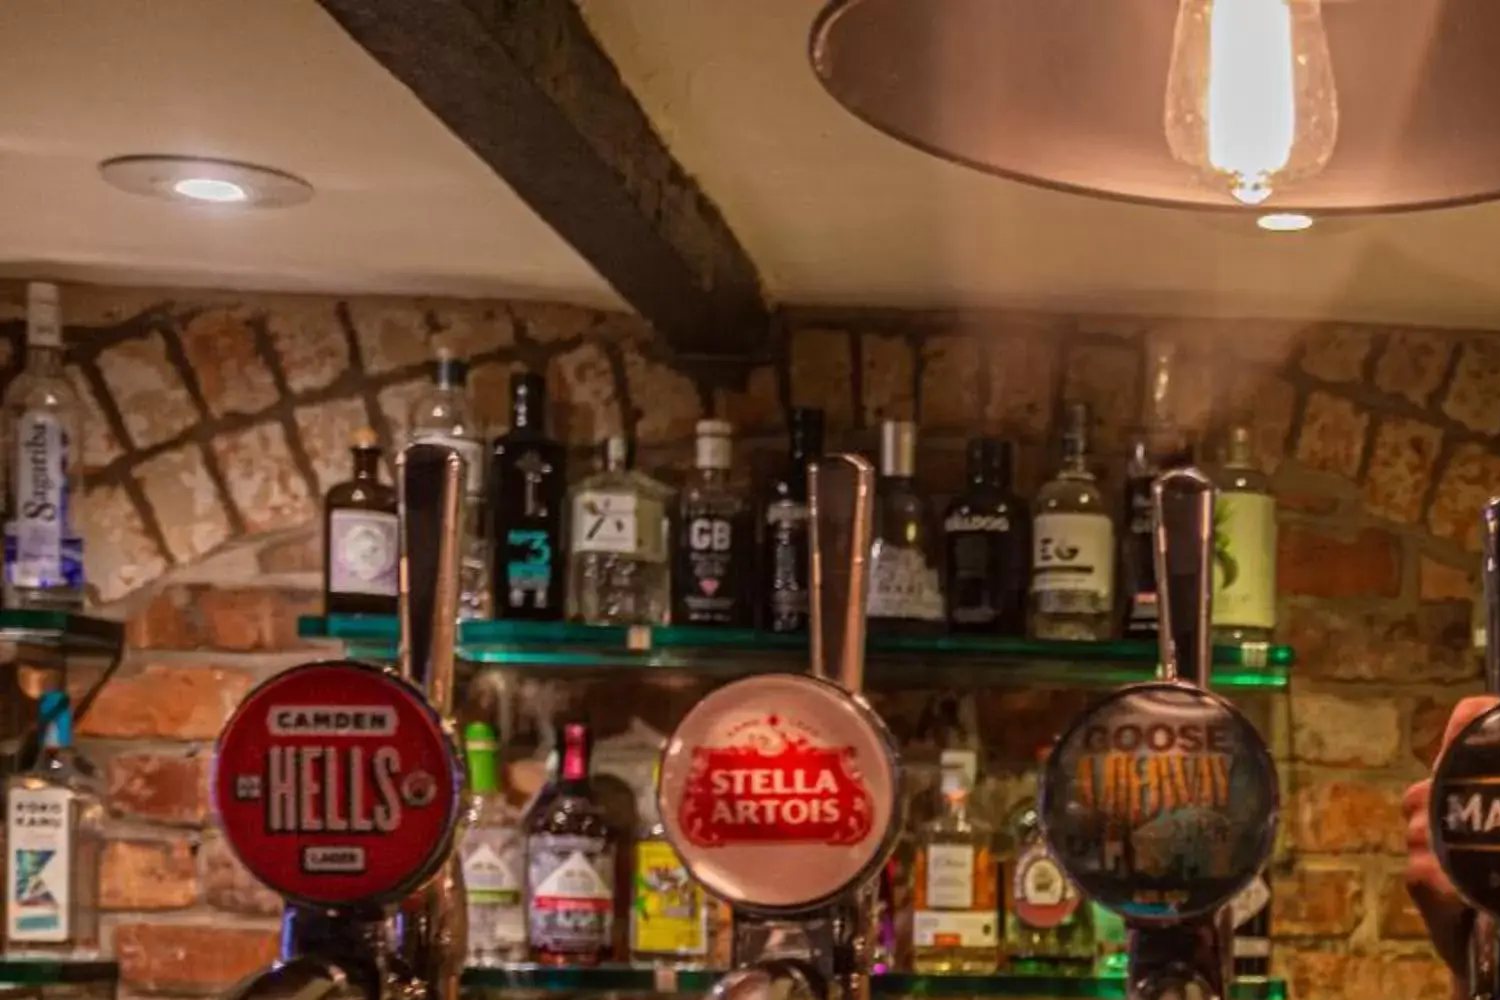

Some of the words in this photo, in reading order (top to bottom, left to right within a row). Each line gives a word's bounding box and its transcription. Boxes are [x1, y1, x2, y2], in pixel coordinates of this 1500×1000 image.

[276, 711, 387, 729] CAMDEN
[1084, 725, 1229, 751] GOOSE
[268, 745, 402, 831] HELLS
[711, 769, 839, 794] STELLA
[711, 800, 841, 824] ARTOIS
